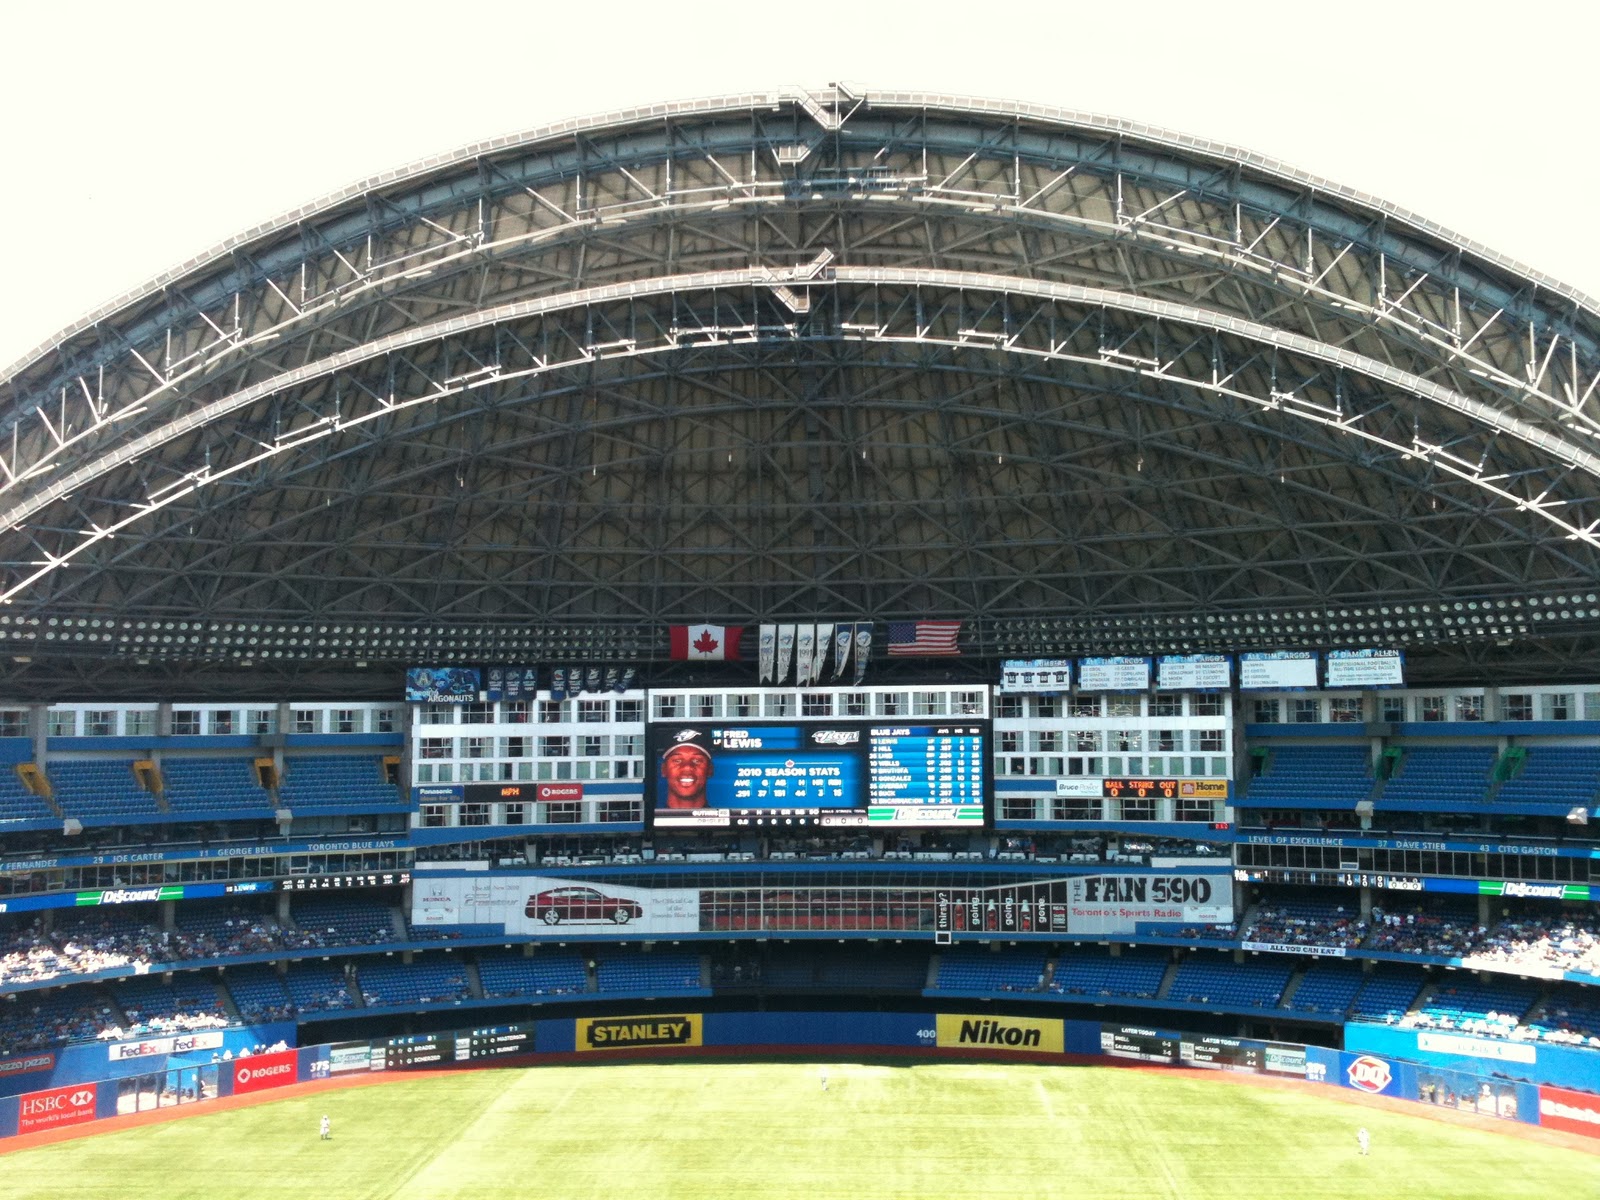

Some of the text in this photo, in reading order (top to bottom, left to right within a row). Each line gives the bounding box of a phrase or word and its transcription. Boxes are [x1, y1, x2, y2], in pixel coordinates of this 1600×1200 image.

[724, 739, 762, 748] LEWIS
[738, 767, 840, 776] 2010 SEASON STATS
[1111, 789, 1172, 798] 0 0 0
[1196, 782, 1225, 791] Home
[1290, 837, 1343, 845] EXCELLENCE
[1498, 845, 1518, 854] CITO
[1522, 846, 1558, 855] GASTON
[6, 859, 58, 870] FERNANDEZ
[113, 854, 128, 863] JOE
[130, 853, 164, 862] CARTER
[218, 848, 252, 856] GEORGE
[308, 842, 349, 850] TORONTO
[1085, 878, 1147, 902] FAN
[1152, 878, 1211, 904] 590
[939, 892, 948, 928] thirsty?
[1072, 908, 1181, 918] Toronto's Sports Radio
[594, 1023, 684, 1041] STANLEY
[916, 1029, 935, 1038] 400
[959, 1020, 1041, 1046] Nikon
[119, 1036, 208, 1058] FedEx FedEx
[24, 1057, 50, 1070] pizza
[310, 1061, 329, 1072] 375
[252, 1064, 291, 1078] ROGERS
[1356, 1063, 1386, 1084] DQ
[22, 1094, 67, 1115] HSBC
[35, 1114, 59, 1123] world's
